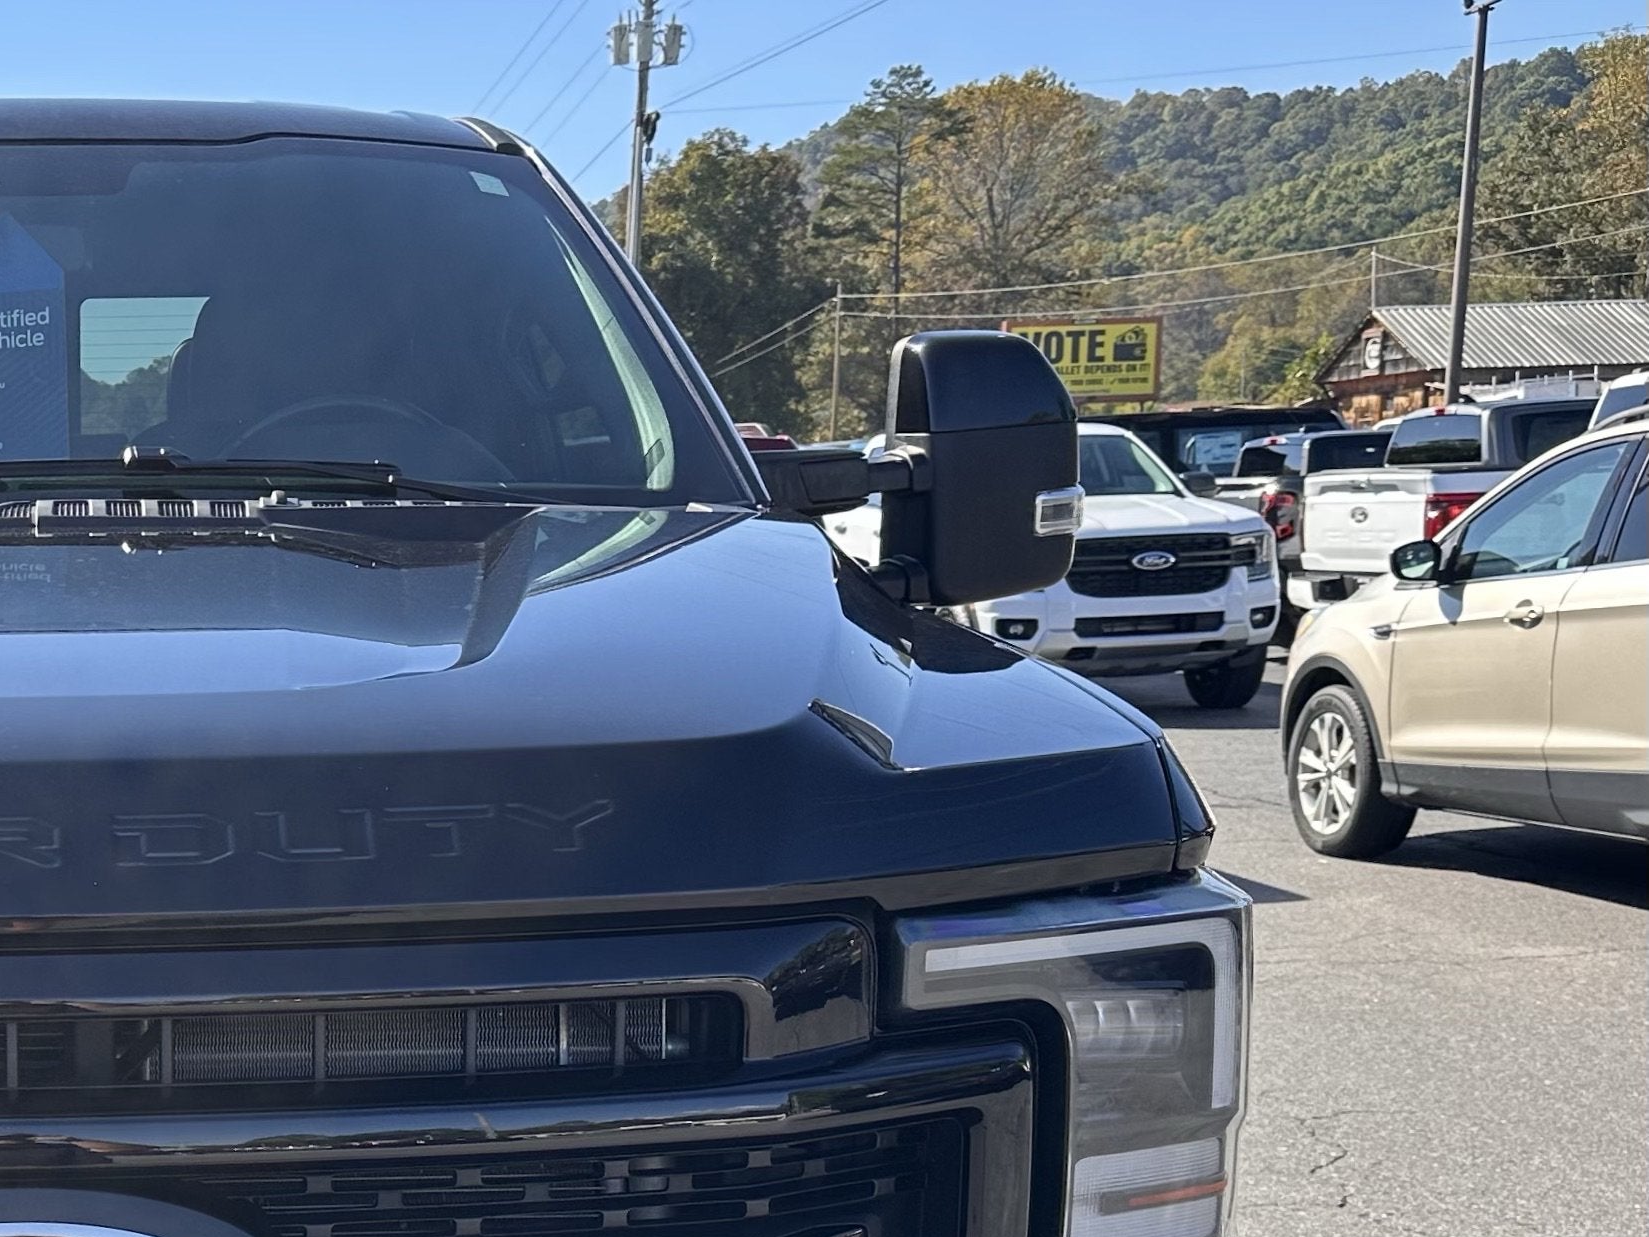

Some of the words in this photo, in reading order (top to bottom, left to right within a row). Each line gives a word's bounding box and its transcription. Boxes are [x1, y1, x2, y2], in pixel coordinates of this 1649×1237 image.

[1055, 365, 1082, 375] ALLET
[1084, 364, 1123, 375] DEPENDS
[1126, 363, 1137, 373] ON
[112, 799, 614, 867] DUTY
